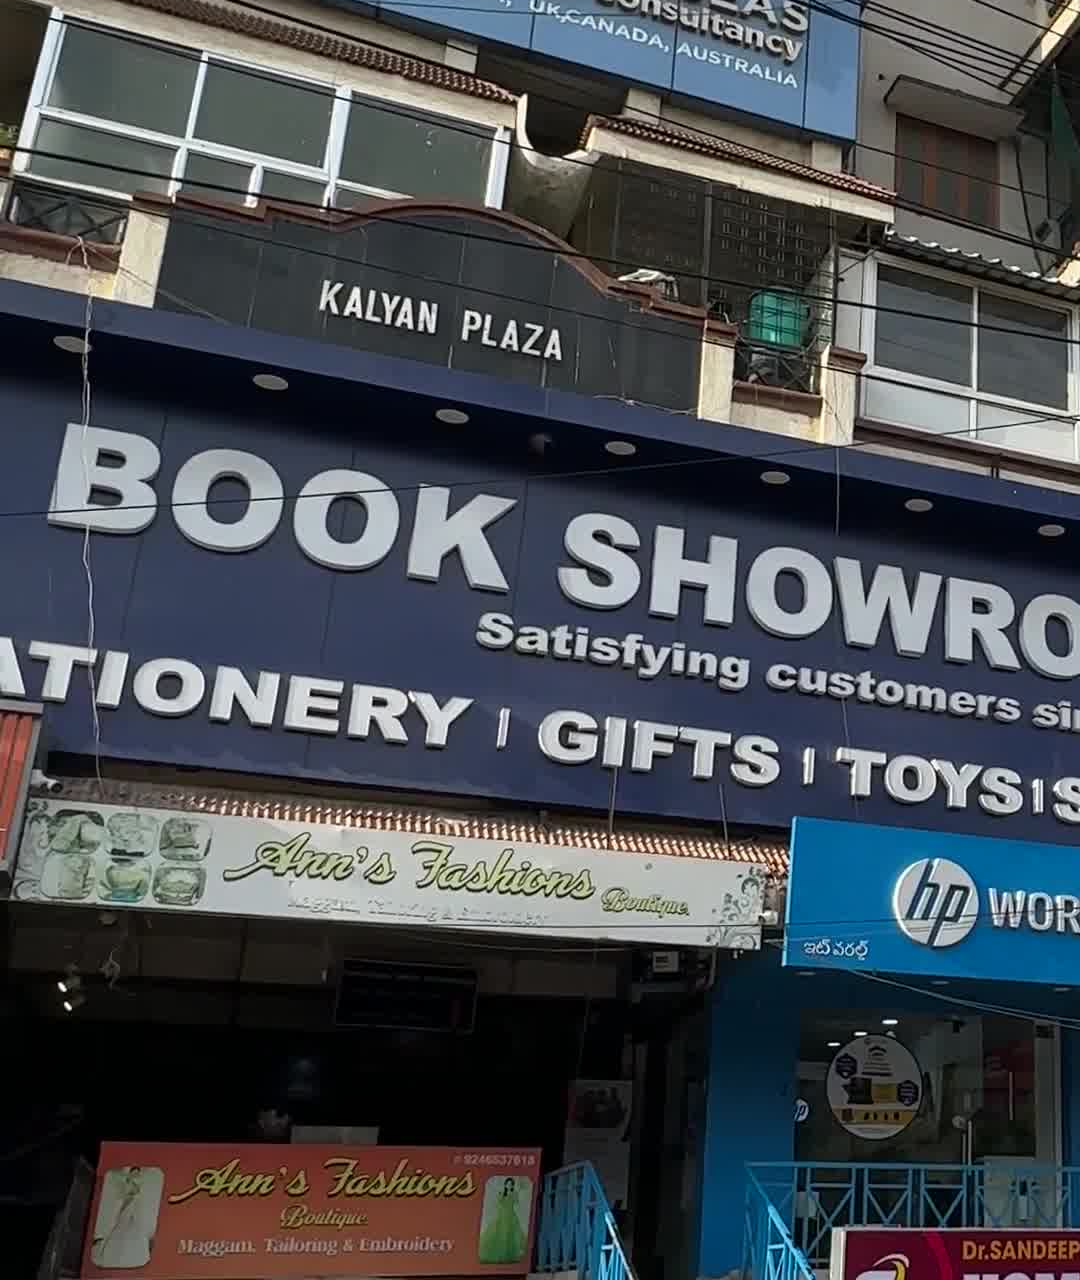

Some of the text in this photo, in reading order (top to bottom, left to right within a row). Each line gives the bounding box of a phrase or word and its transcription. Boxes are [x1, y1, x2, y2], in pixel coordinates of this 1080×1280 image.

[676, 41, 798, 88] AUSTRALIA
[319, 278, 564, 362] KALYAN PLAZA
[47, 423, 519, 593] BOOK
[476, 611, 751, 691] Satisfying
[765, 660, 1022, 723] customers
[537, 707, 783, 790] GIFTS
[838, 747, 1024, 817] TOYS
[223, 832, 396, 884] Ann's
[411, 840, 596, 899] Fashions
[905, 858, 971, 948] hp
[168, 1157, 477, 1205] Ann's Fashions
[264, 1236, 339, 1256] Tailoring
[342, 1239, 353, 1253] &
[359, 1236, 455, 1255] Embroidery
[962, 1240, 1080, 1261] Dr.SANDEEP
